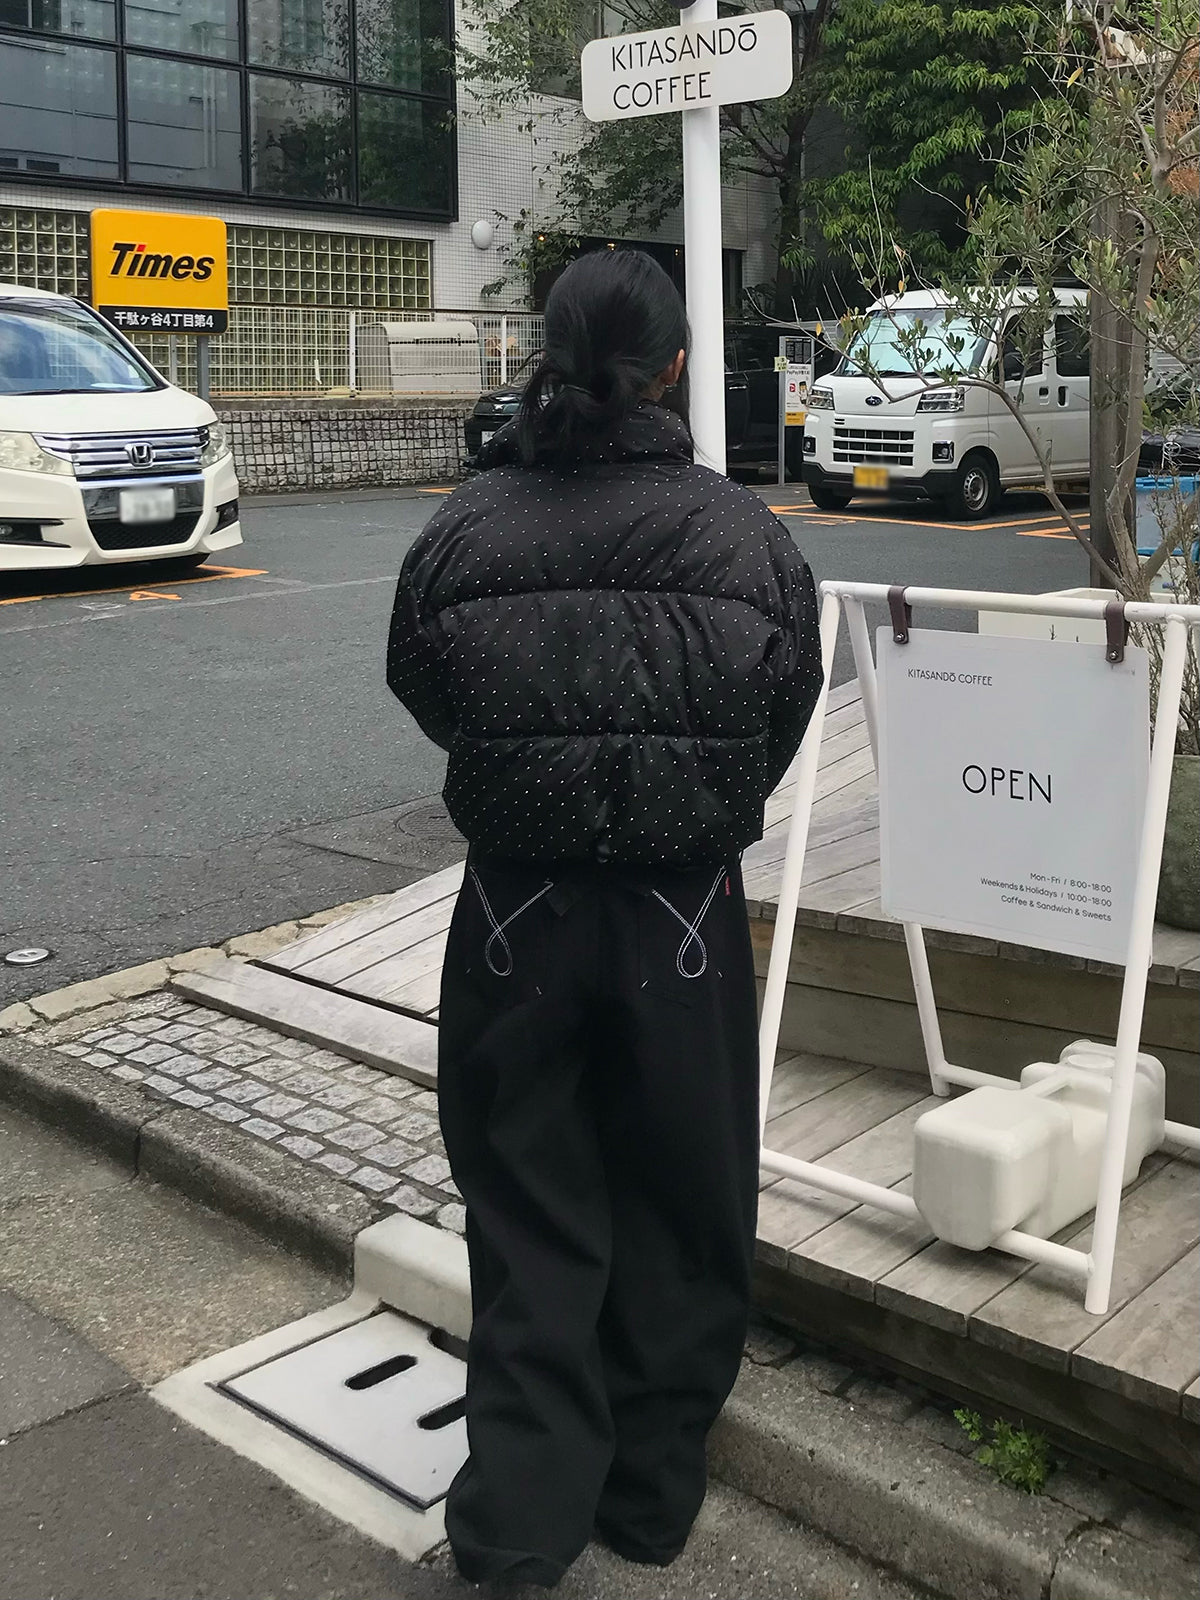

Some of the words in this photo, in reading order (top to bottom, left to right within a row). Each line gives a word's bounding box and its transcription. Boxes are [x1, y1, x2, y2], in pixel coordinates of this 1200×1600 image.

[612, 23, 757, 71] KITASANDŌ
[613, 71, 711, 109] COFFEE
[110, 242, 215, 280] Times
[958, 673, 993, 686] COFFEE
[962, 765, 1051, 803] OPEN
[980, 878, 1018, 891] Weekends
[1025, 886, 1058, 898] Holidays
[1001, 895, 1028, 906] Coffee
[1029, 900, 1035, 908] &
[1036, 901, 1073, 915] Sandwich
[1074, 908, 1080, 916] &
[1082, 909, 1112, 921] Sweets
